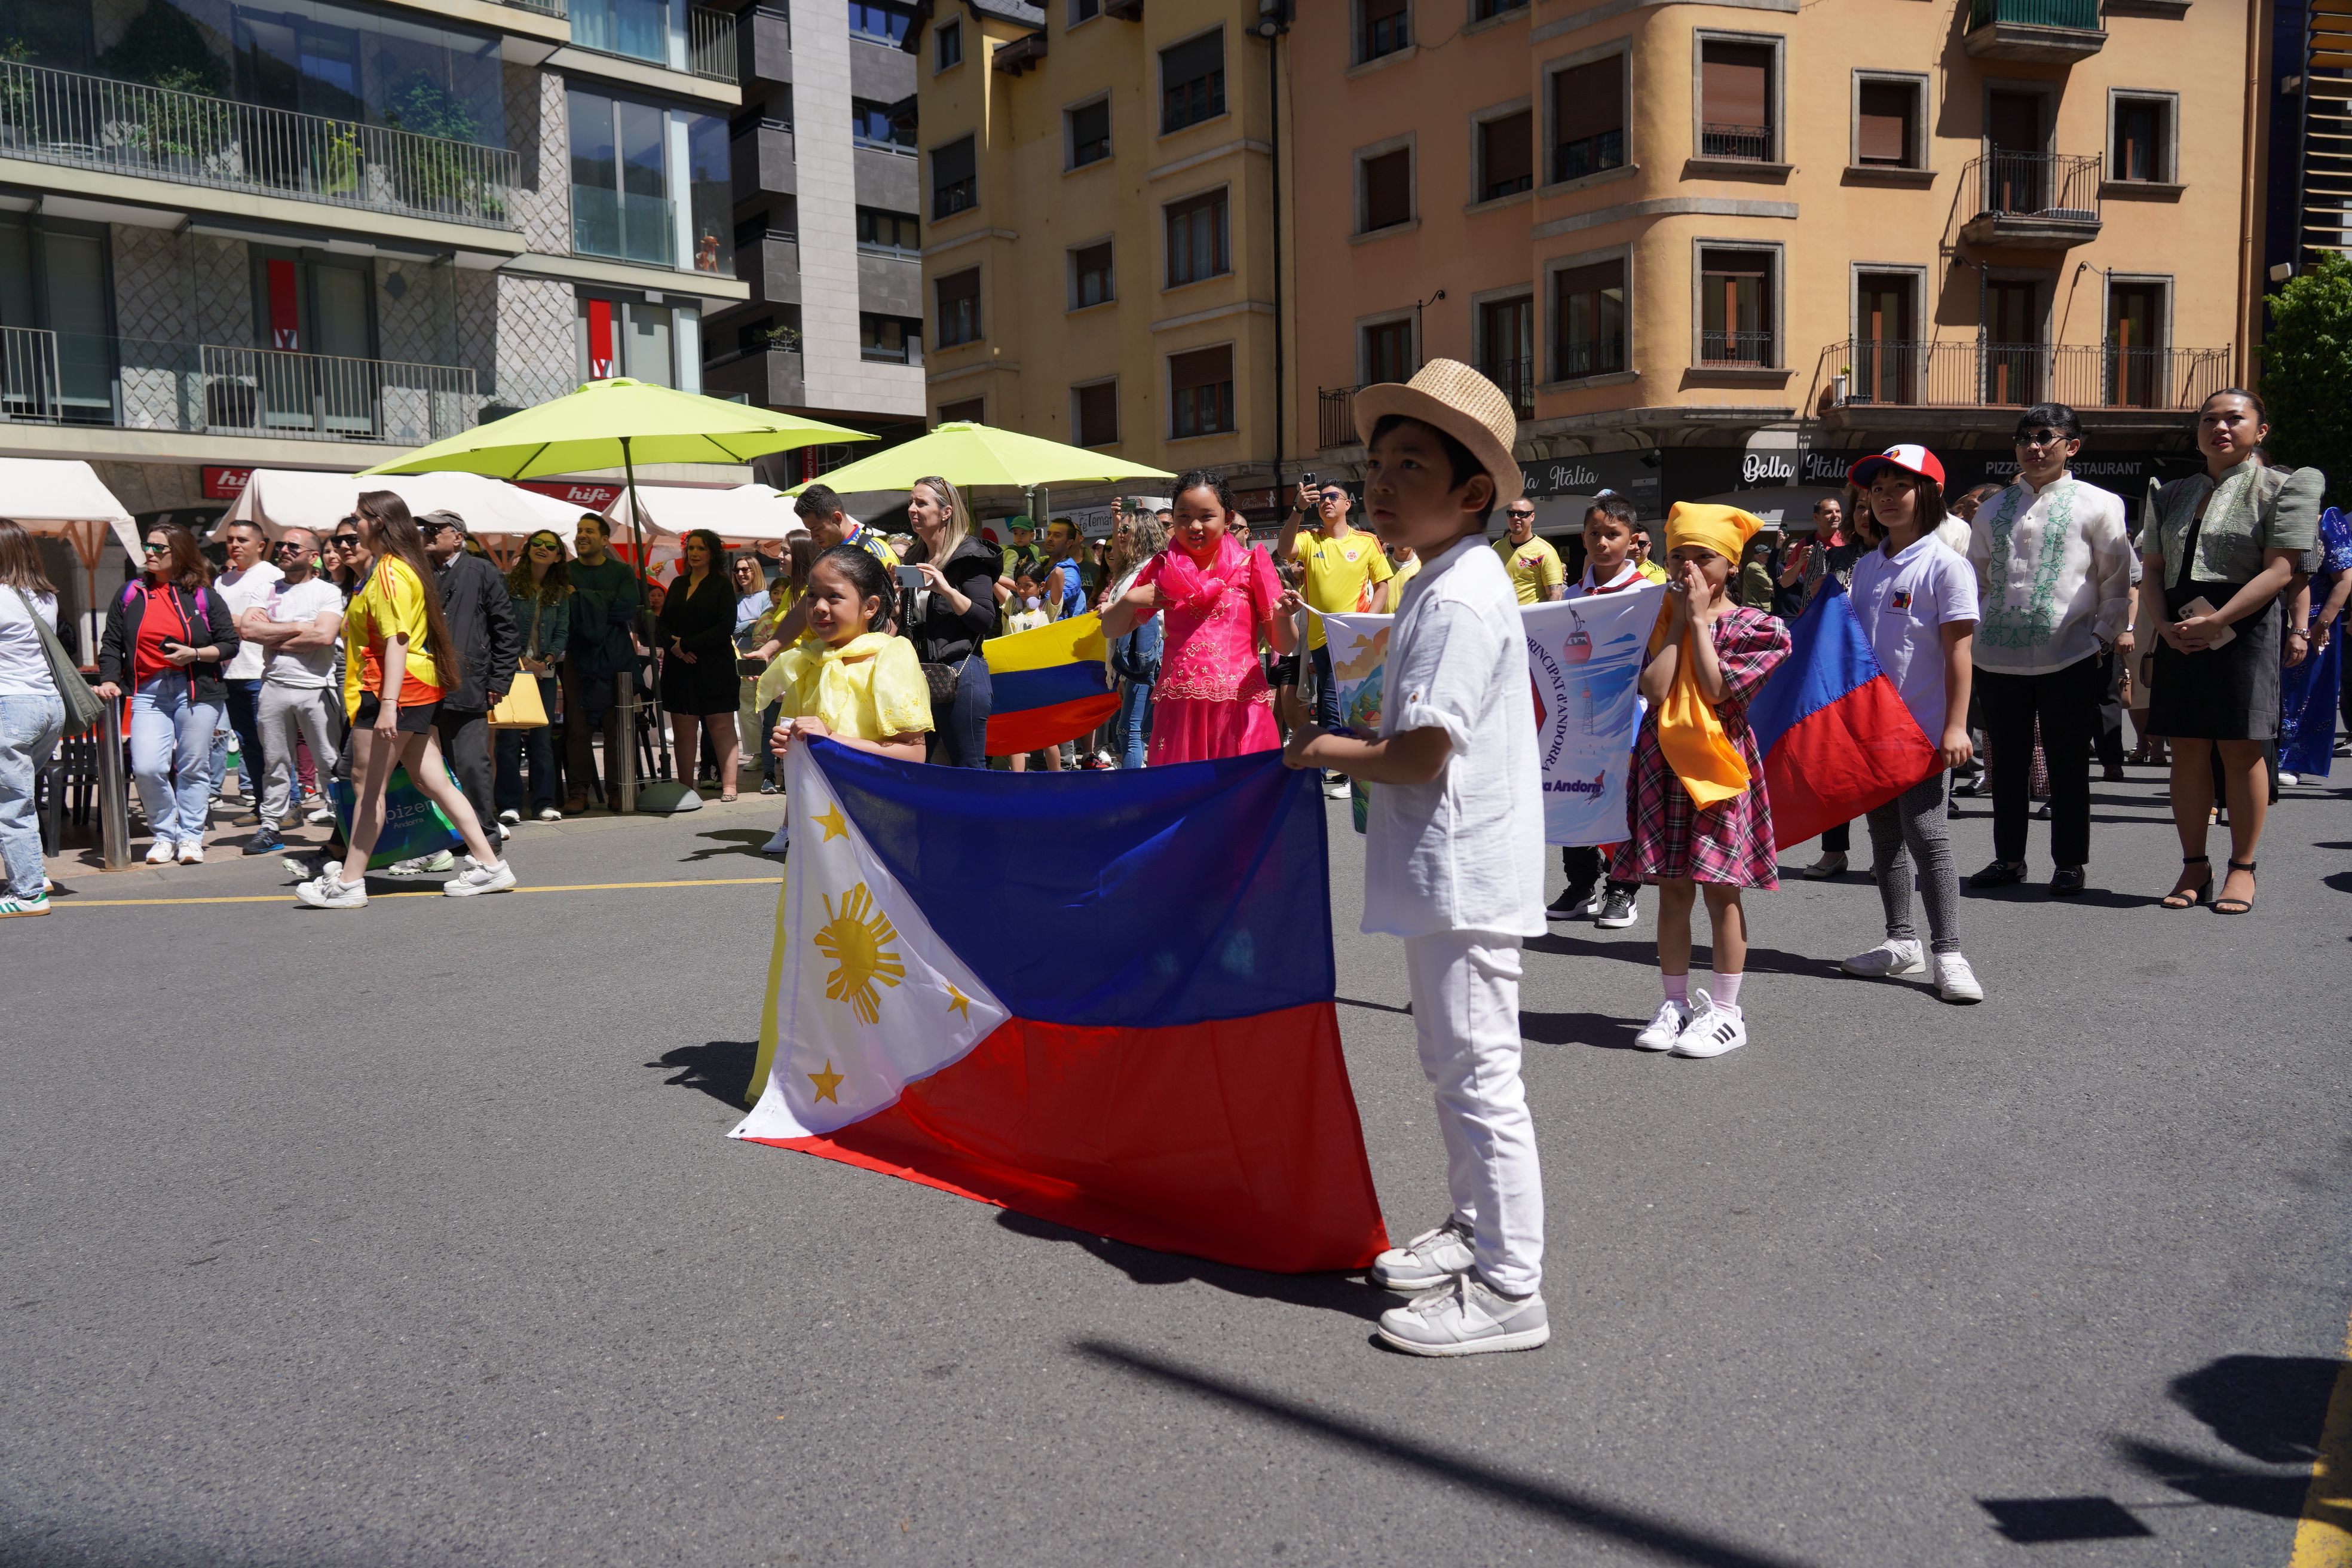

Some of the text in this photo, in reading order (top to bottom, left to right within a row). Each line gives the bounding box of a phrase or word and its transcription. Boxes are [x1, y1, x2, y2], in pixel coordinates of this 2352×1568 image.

[1743, 454, 1796, 482] Bella
[1986, 461, 2142, 476] PIZZE ESTAURANT
[217, 470, 249, 486] hi
[1549, 465, 1599, 491] Italia
[567, 486, 612, 503] hife
[1080, 510, 1112, 527] Temàt
[1542, 693, 1568, 772] d'ANDORRA
[385, 800, 434, 824] pizen
[393, 818, 424, 829] Andorra
